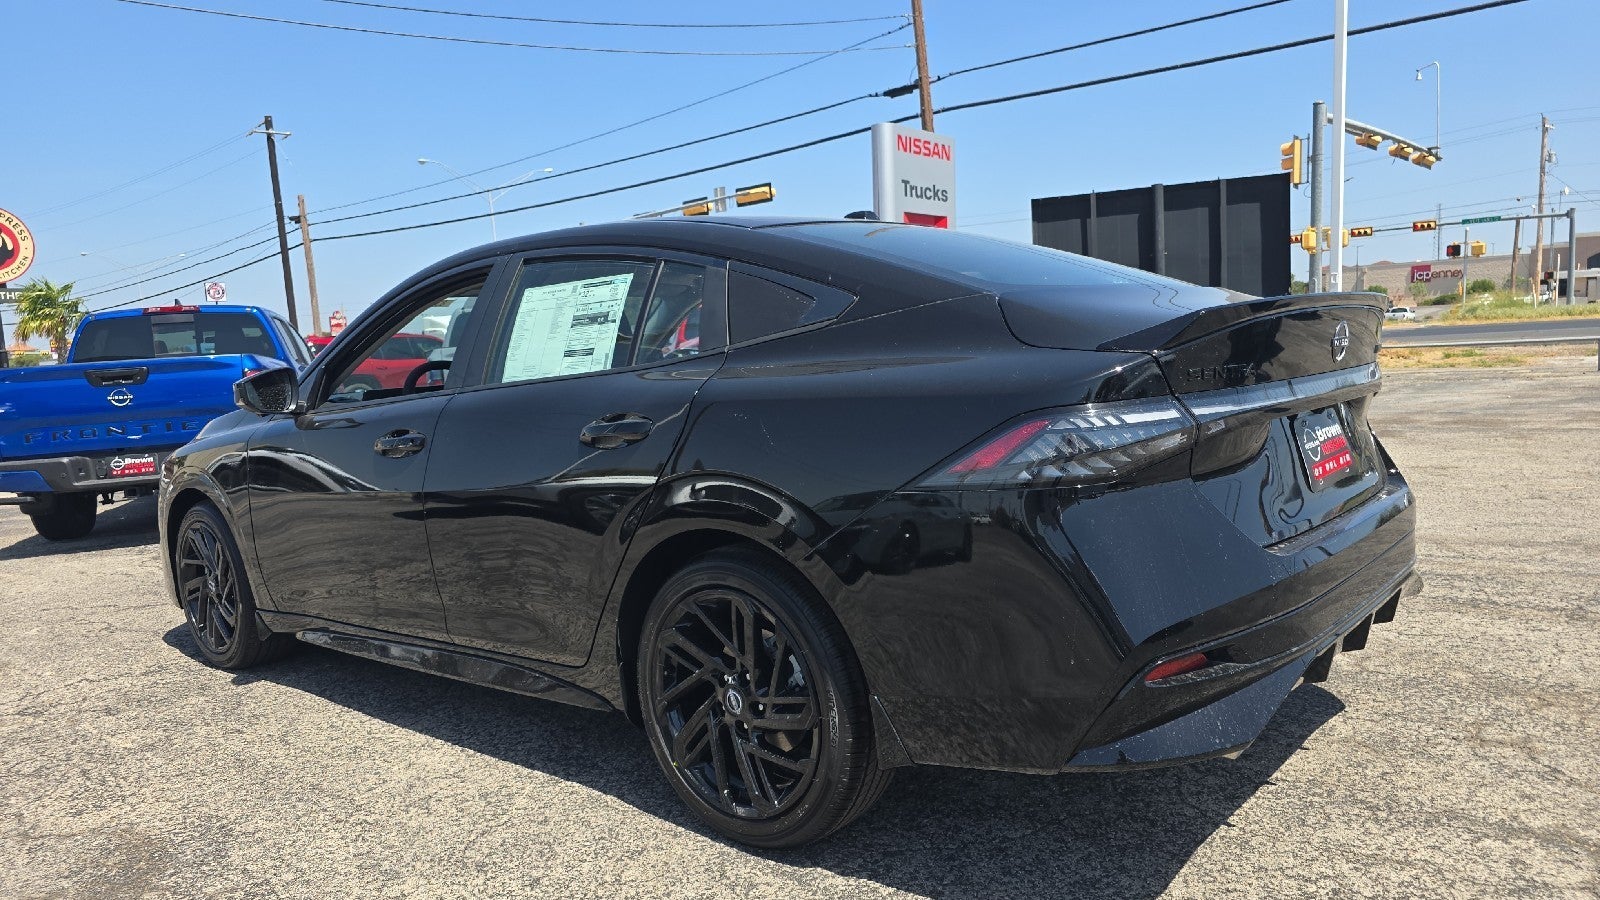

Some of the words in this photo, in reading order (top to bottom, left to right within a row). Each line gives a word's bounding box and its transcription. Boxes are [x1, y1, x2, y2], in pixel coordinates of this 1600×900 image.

[897, 134, 951, 161] NISSAN
[901, 179, 948, 203] Trucks
[0, 255, 29, 280] ITCHEN
[1414, 269, 1464, 281] jcpenney
[24, 418, 212, 444] FRONTIE
[1315, 423, 1342, 441] Brown
